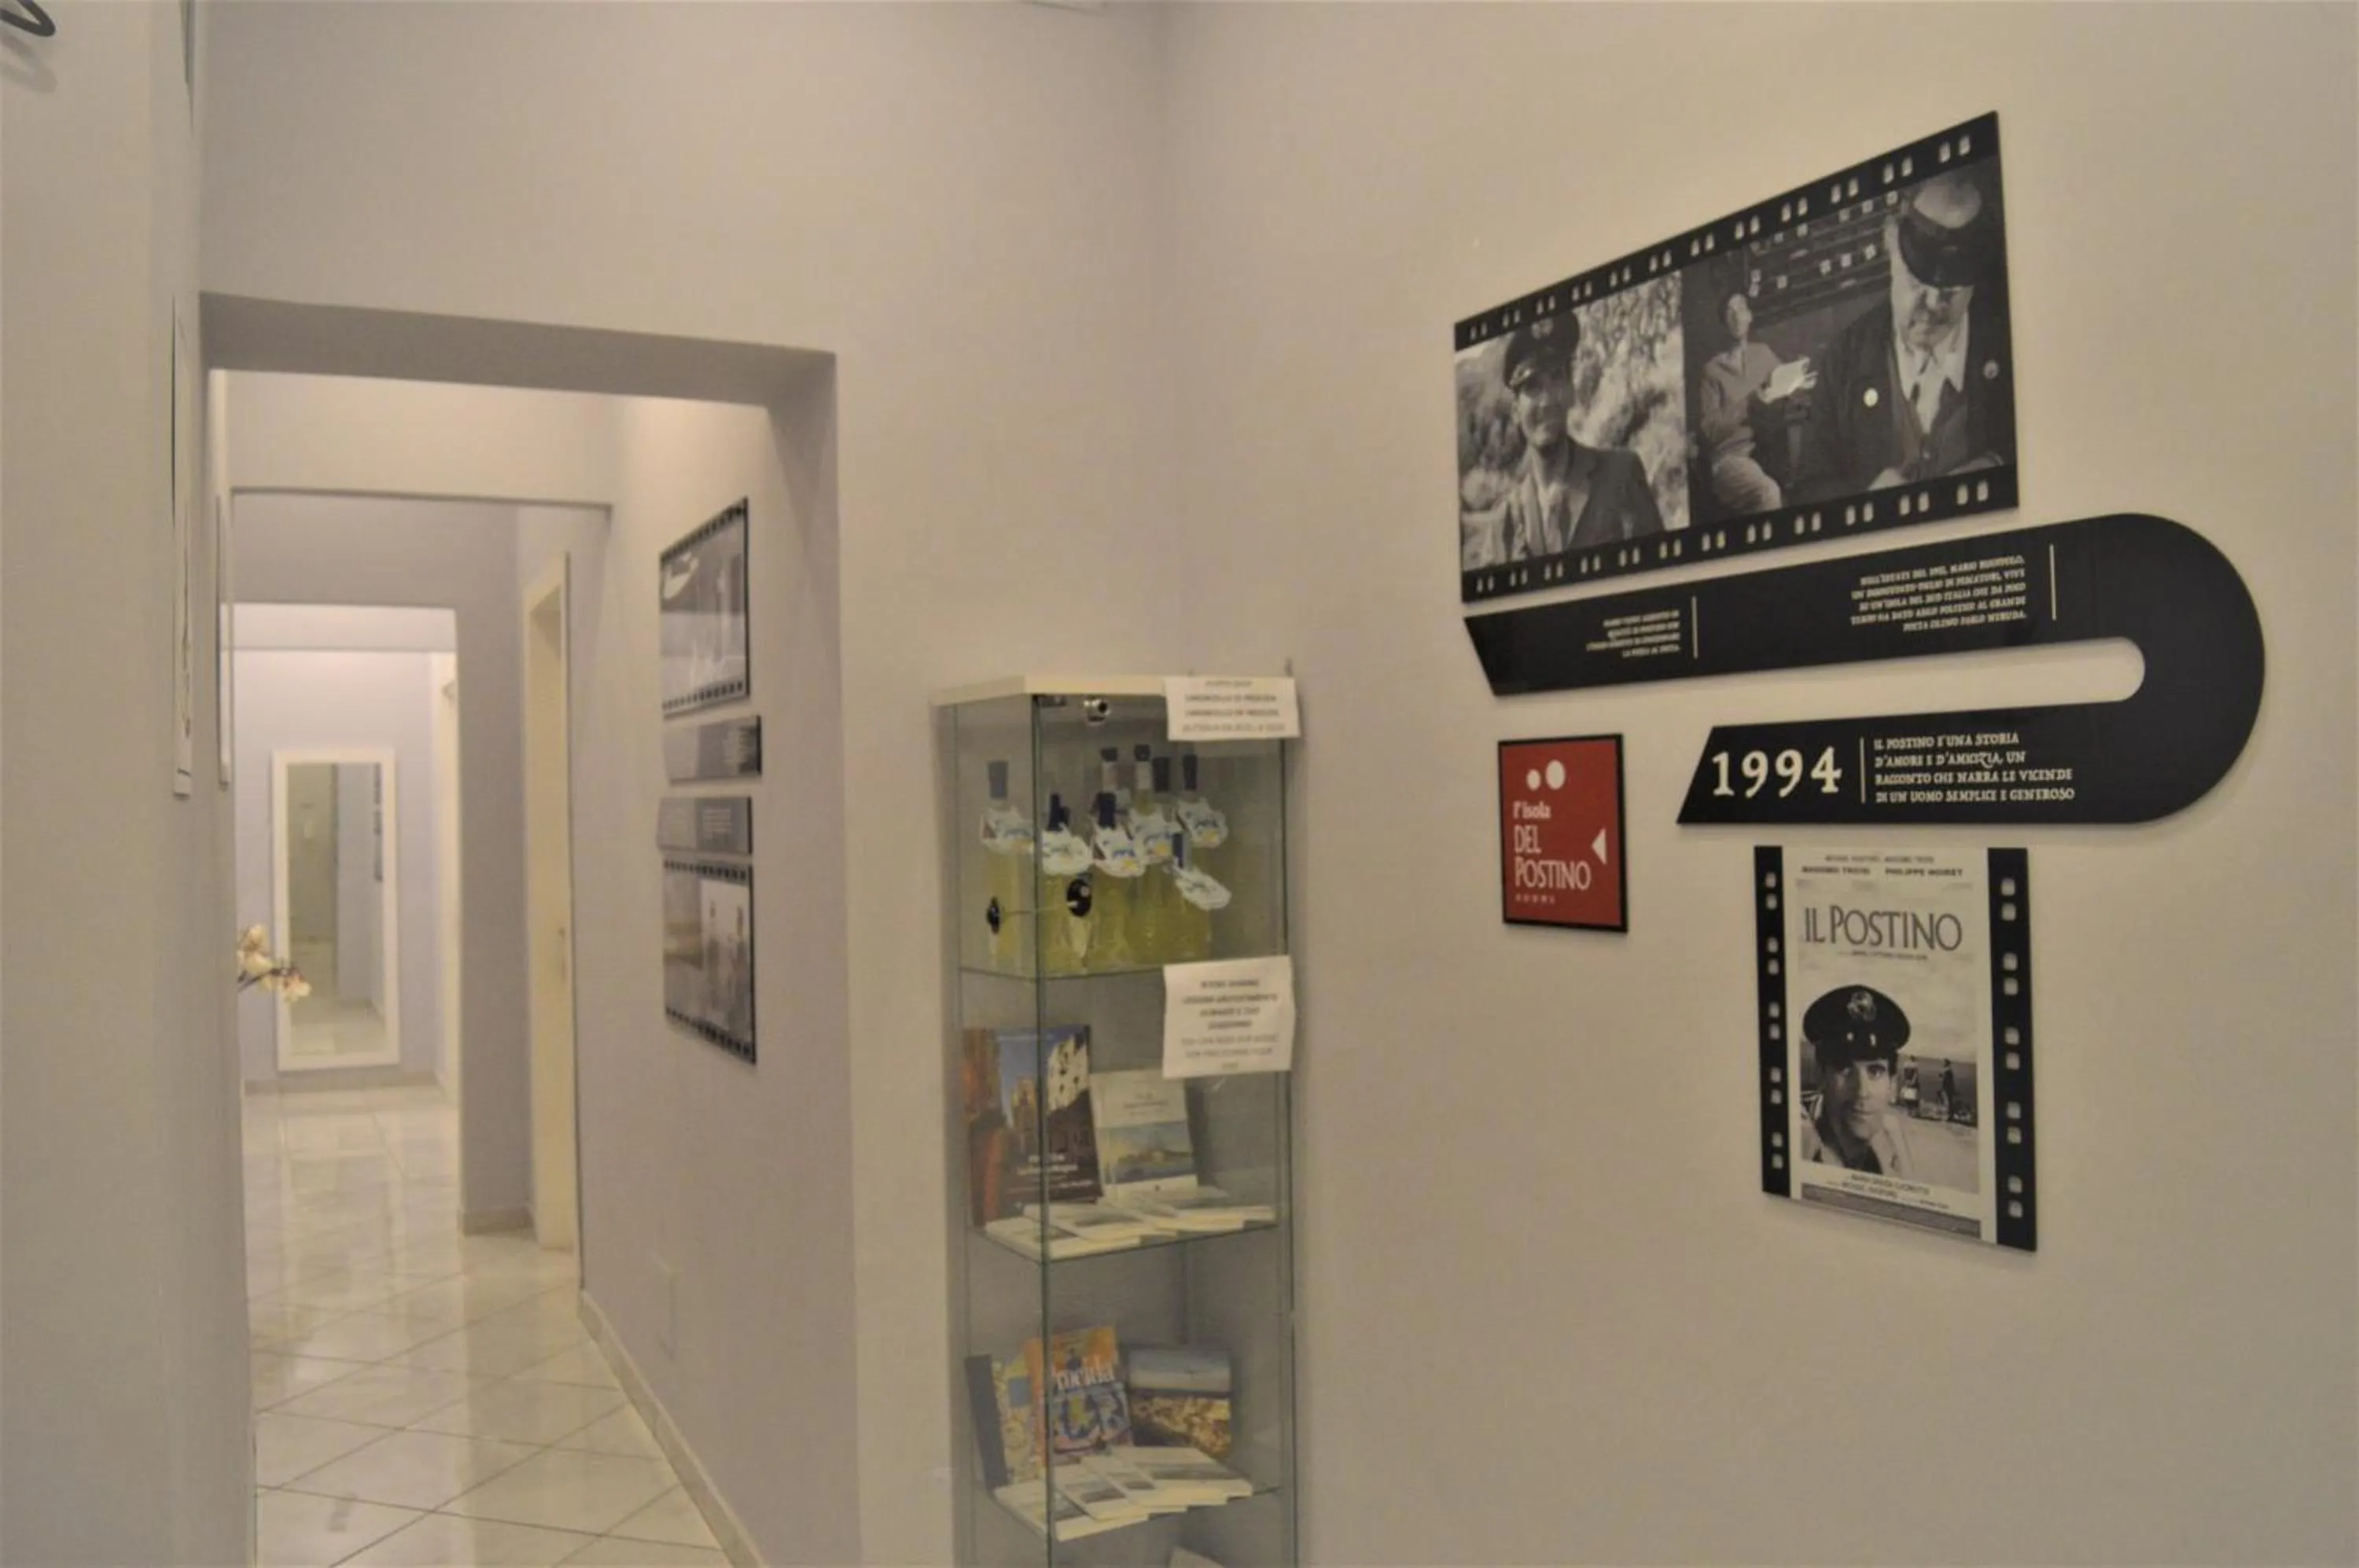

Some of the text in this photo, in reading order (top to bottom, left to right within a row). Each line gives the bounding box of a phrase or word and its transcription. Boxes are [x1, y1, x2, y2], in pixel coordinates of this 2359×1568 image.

[1886, 736, 1934, 749] POSTINO
[1975, 733, 2019, 746] STORIA
[1875, 754, 1923, 768] D'AMORE
[1927, 754, 1932, 766] E
[2006, 751, 2026, 764] UN
[1712, 745, 1842, 798] 1994
[1875, 768, 2073, 786] RACCONTO CHE NARRA LE VICENDE
[1875, 787, 2075, 803] DI UN UOMO SEMPLICE E GENEROSO
[1513, 801, 1551, 819] l'isola
[1514, 824, 1541, 854] DEL
[1514, 856, 1592, 891] POSTINO
[1805, 905, 1963, 951] IL POSTINO
